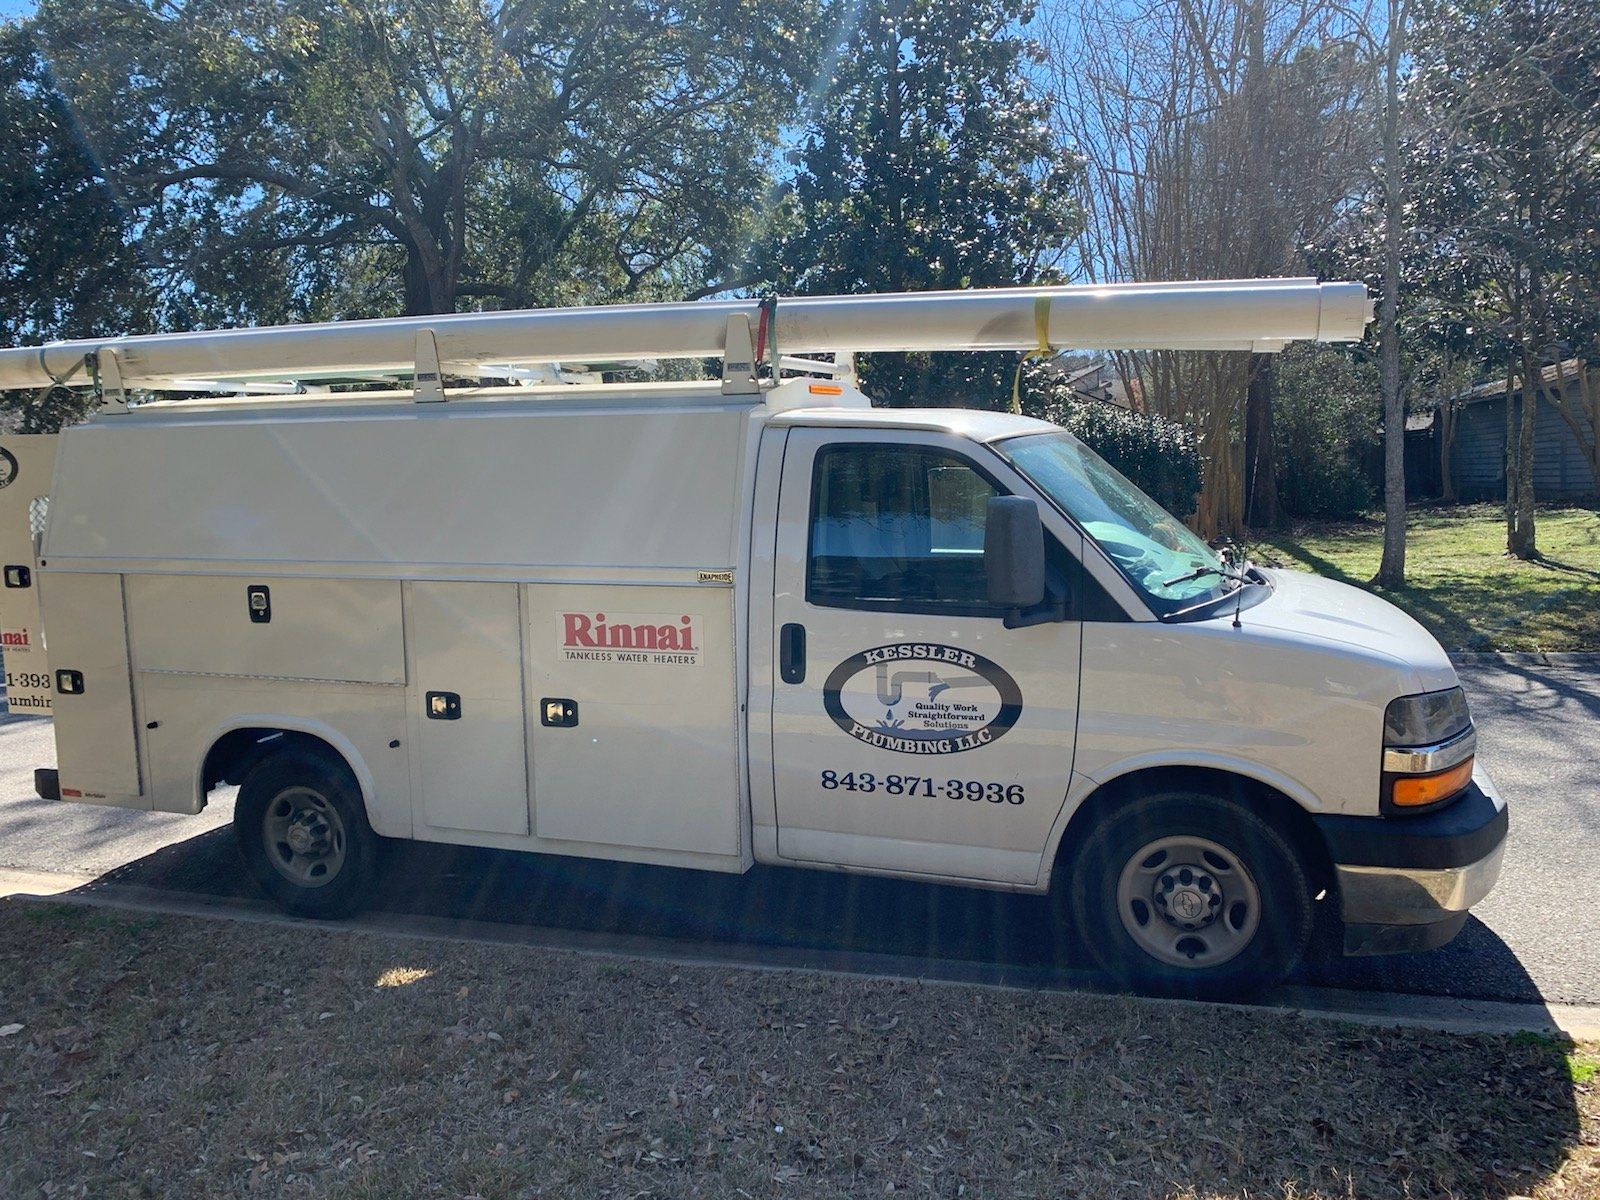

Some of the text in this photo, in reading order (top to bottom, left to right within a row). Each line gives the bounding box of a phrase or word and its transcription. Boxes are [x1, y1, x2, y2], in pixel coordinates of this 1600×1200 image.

[563, 613, 693, 650] Rinnai
[566, 651, 696, 665] TANKLESS WATER HEATERS
[863, 644, 976, 668] KESSLER
[907, 710, 985, 722] Straightforward
[915, 702, 978, 712] Quality Work
[923, 720, 969, 729] Solutions
[851, 722, 992, 754] PLUMBING LLC
[821, 769, 1025, 805] 843-871-3936
